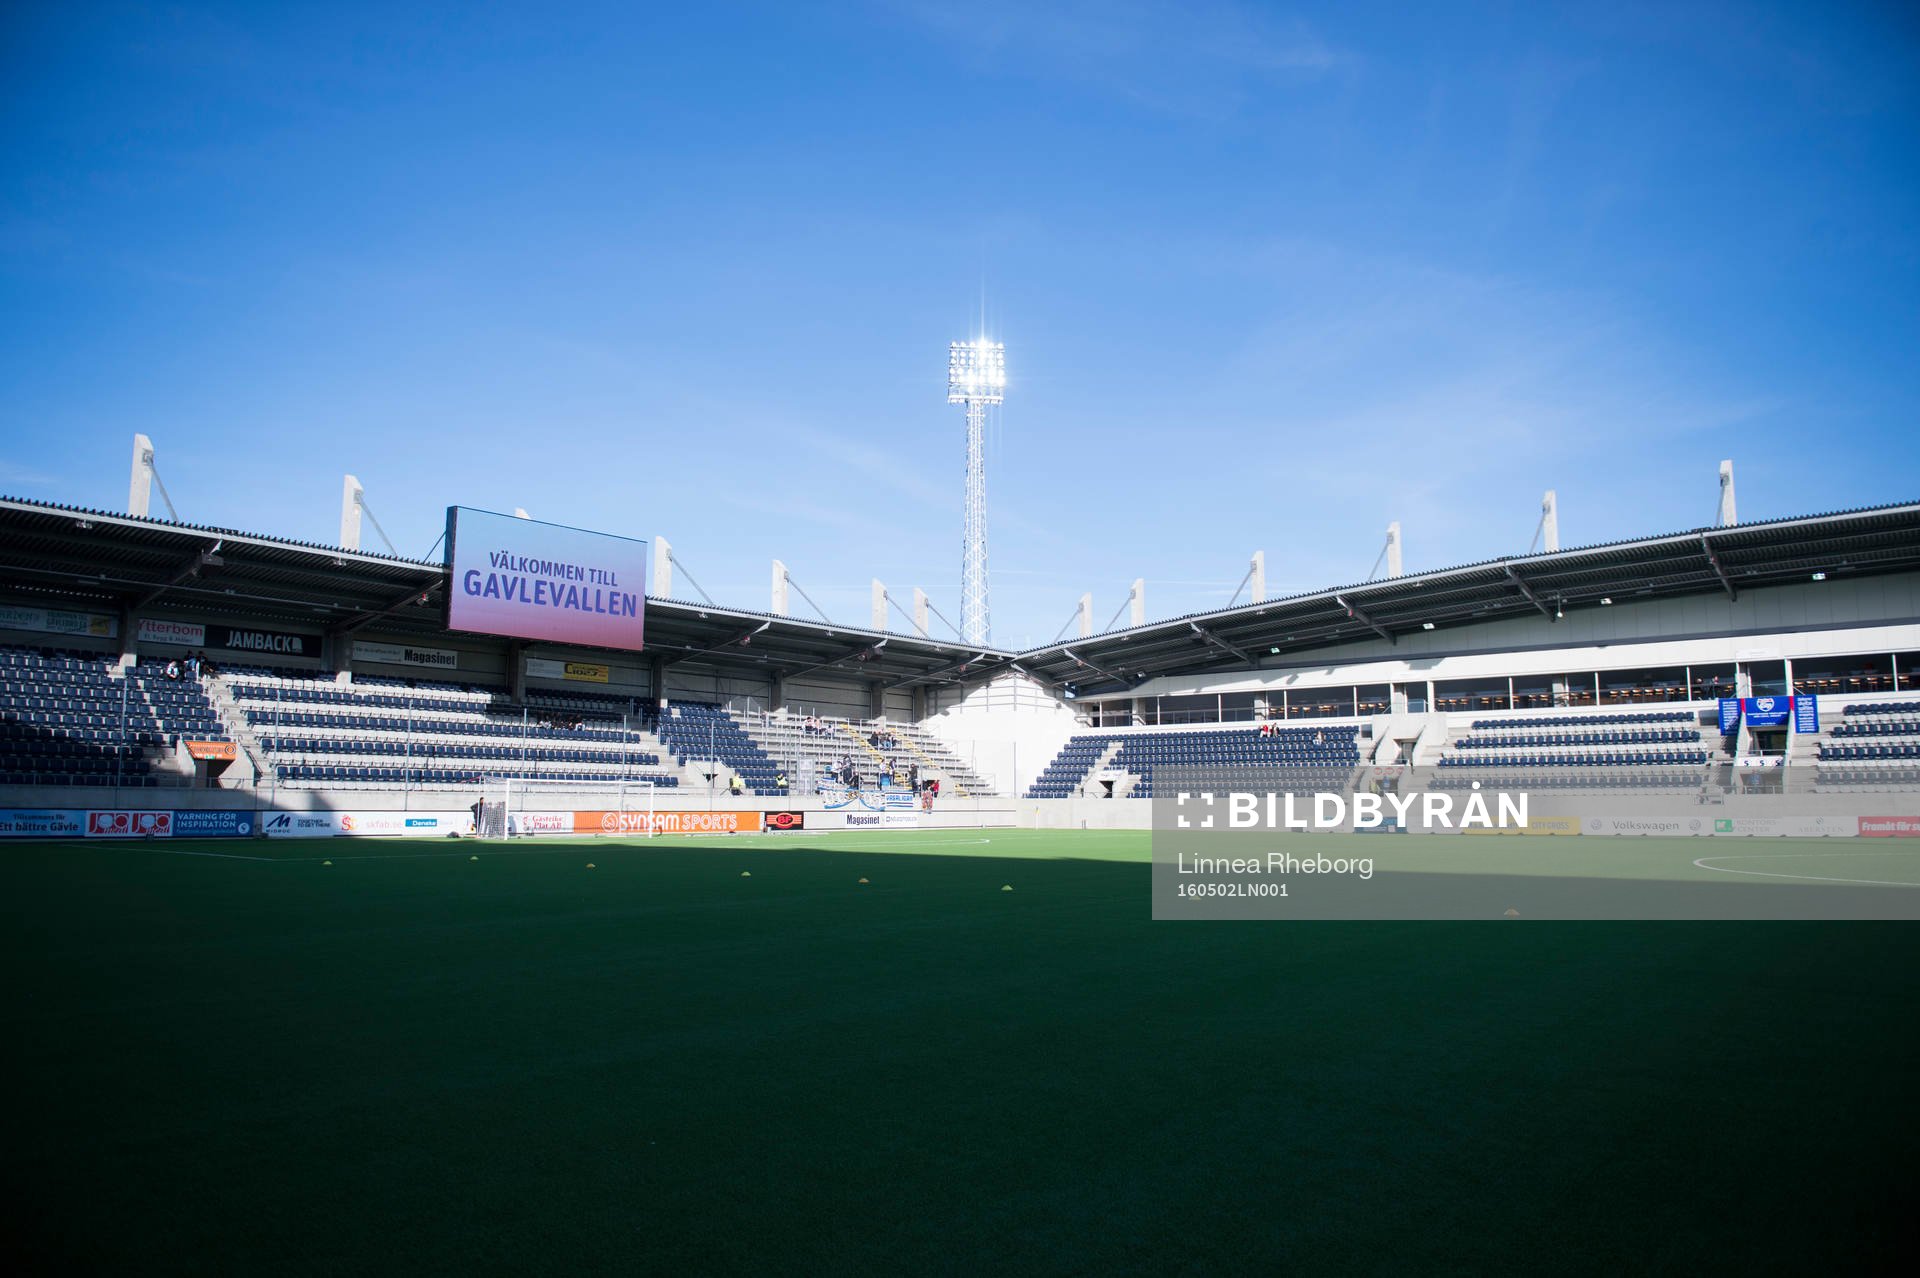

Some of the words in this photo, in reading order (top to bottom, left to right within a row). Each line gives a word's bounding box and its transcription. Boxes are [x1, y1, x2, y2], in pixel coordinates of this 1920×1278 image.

[490, 551, 584, 581] VÄLKOMMEN
[589, 568, 618, 587] TILL
[463, 569, 637, 618] GAVLEVALLEN
[226, 630, 295, 652] JAMBACK
[404, 648, 456, 666] Magasinet
[177, 812, 217, 820] VARNING
[219, 811, 236, 820] FÖR
[846, 814, 880, 825] Magasinet
[15, 822, 48, 831] bättre
[50, 821, 79, 832] Gävle
[177, 820, 236, 828] INSPIRATION
[682, 814, 737, 830] SPORTS
[1612, 820, 1680, 830] Volkswagen
[1862, 821, 1895, 831] Framåt
